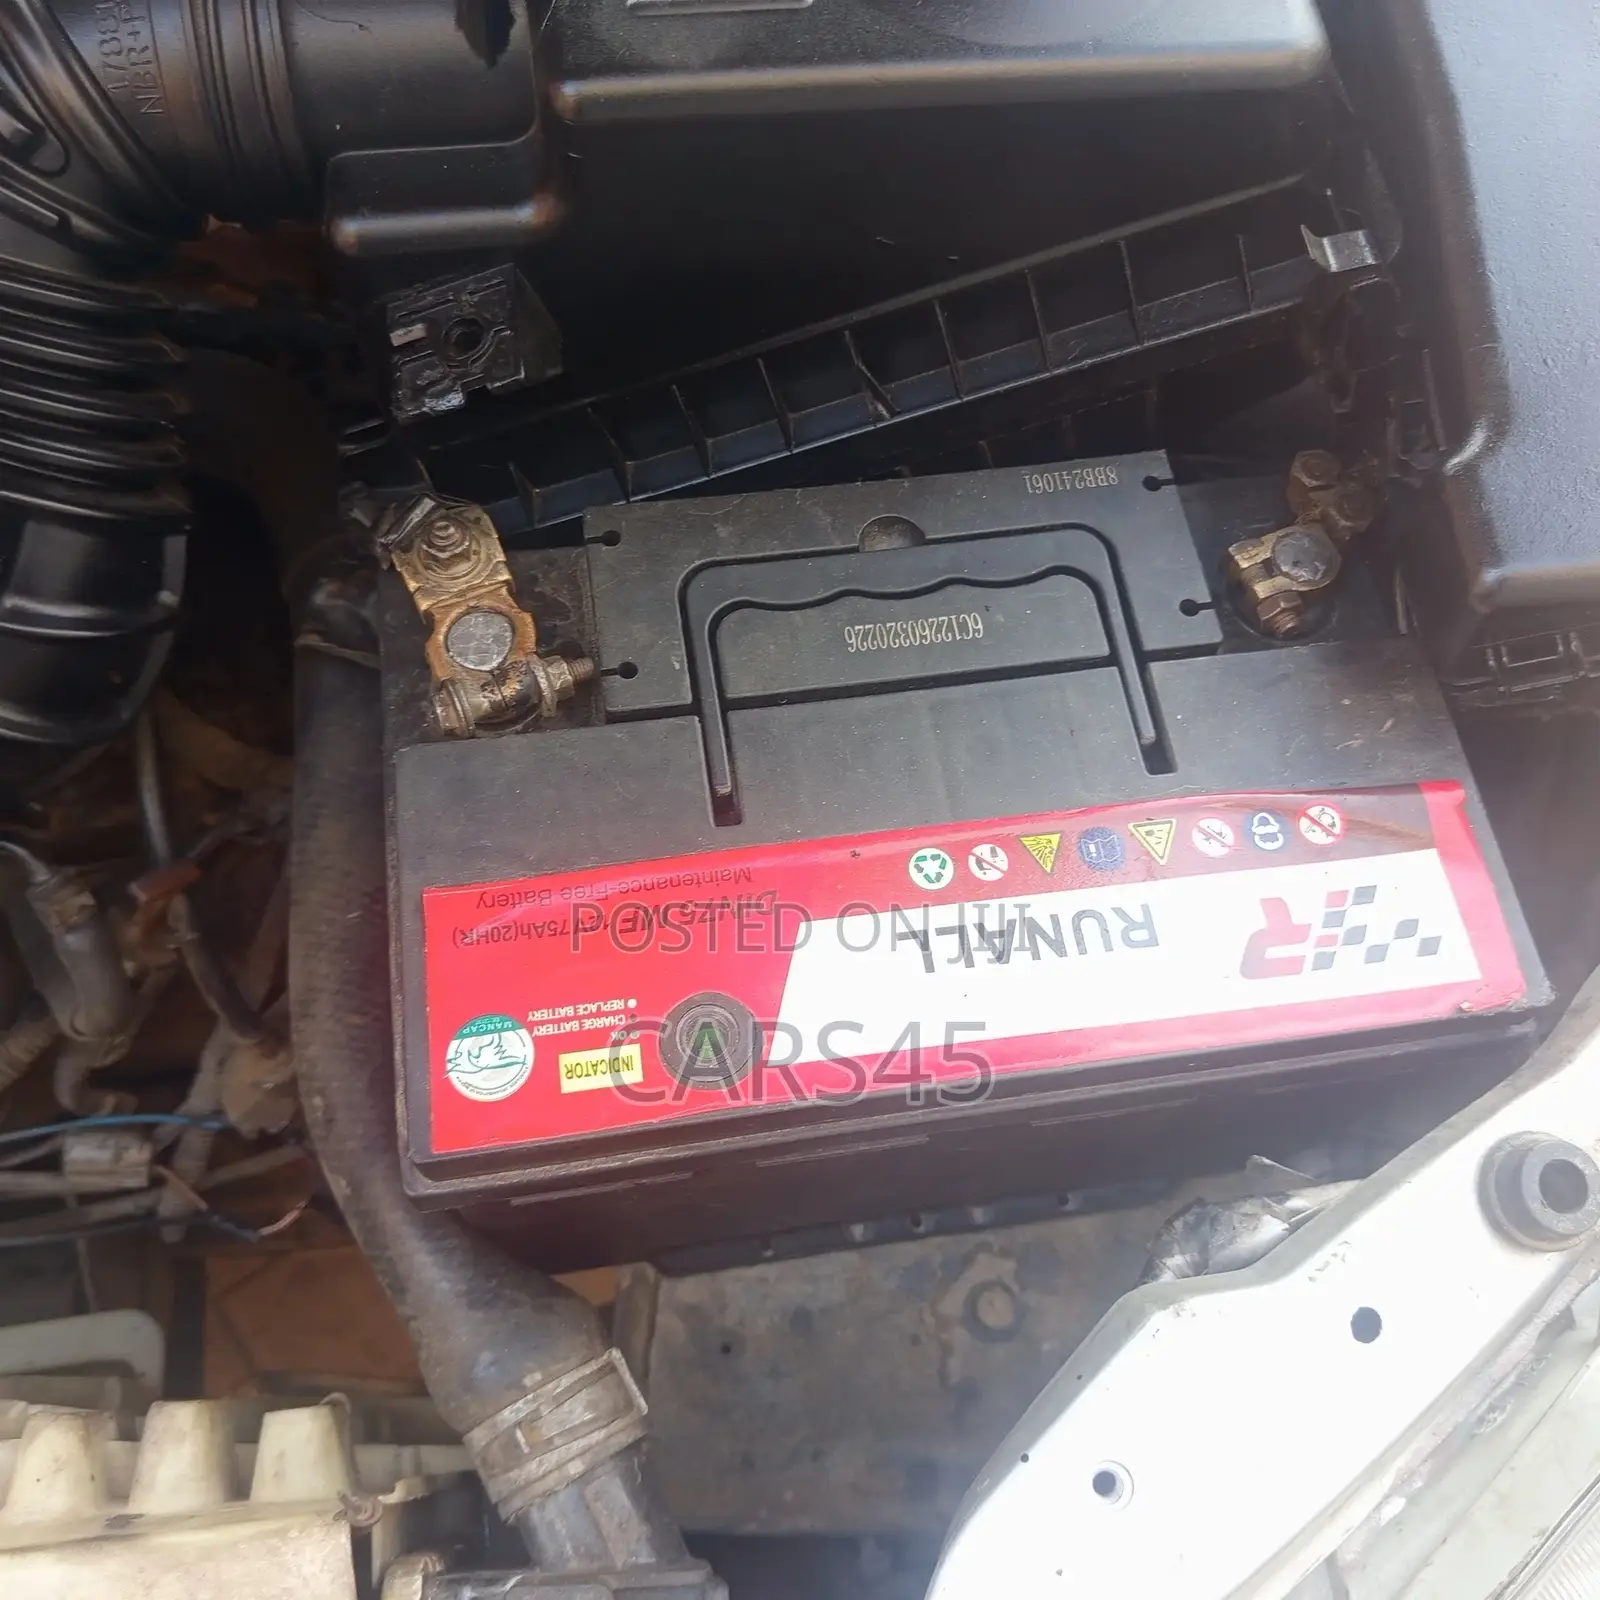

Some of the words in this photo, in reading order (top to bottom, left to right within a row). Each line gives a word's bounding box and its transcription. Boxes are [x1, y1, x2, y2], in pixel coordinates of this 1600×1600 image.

[1022, 465, 1119, 495] 8BB241061
[844, 612, 985, 653] 6C12260320226
[559, 866, 753, 903] Maintenance-Free
[475, 888, 553, 910] Battery
[677, 889, 779, 927] DIN75
[897, 902, 1161, 975] RUNALL
[526, 1005, 575, 1022] BATTERY
[576, 998, 625, 1015] REPLACE
[462, 1020, 513, 1035] MANCAP
[531, 1021, 580, 1038] BATTERY
[581, 1014, 626, 1031] CHARGE
[610, 1030, 628, 1042] OK
[564, 1054, 634, 1080] INDICATOR
